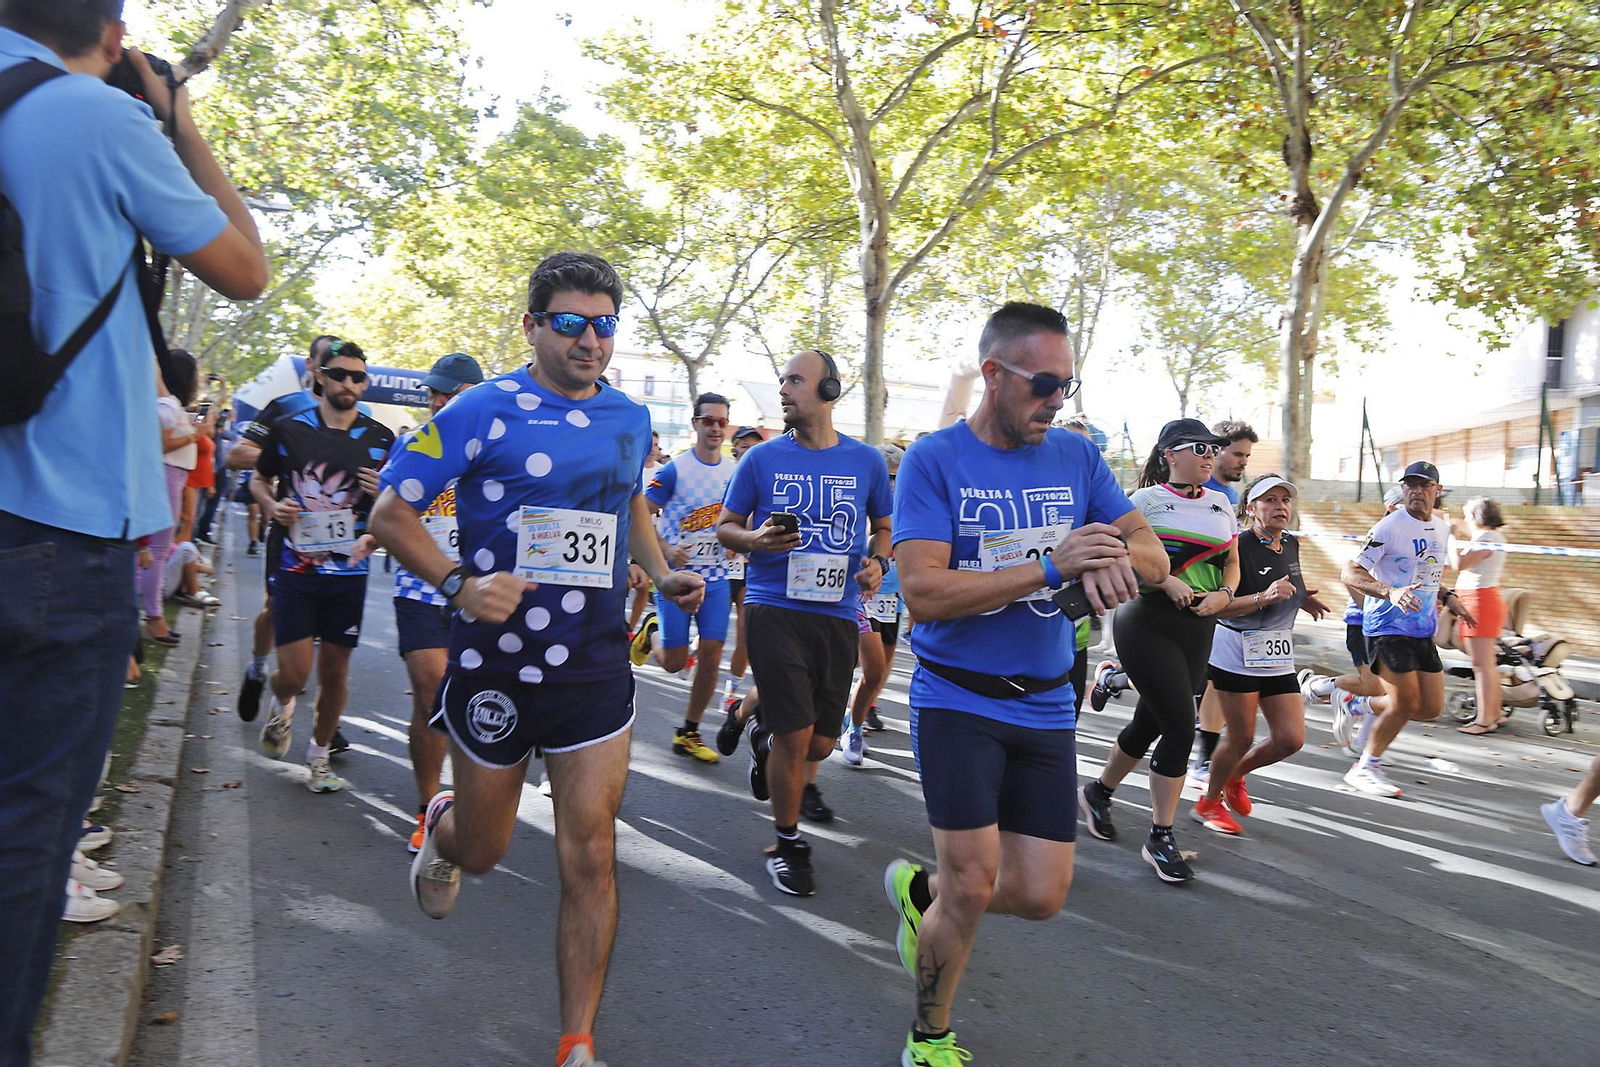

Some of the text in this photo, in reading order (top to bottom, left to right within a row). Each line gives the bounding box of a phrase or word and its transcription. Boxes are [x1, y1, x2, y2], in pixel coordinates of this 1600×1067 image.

[774, 473, 804, 482] VUELTA
[960, 487, 1013, 499] VUELTA A
[1028, 491, 1070, 502] 12/10/22
[527, 522, 560, 532] 35 VUELTA
[580, 516, 602, 526] EMILIO
[326, 521, 346, 539] 13
[537, 531, 561, 540] HUELVA
[563, 531, 609, 566] 331
[697, 542, 719, 556] 276
[990, 548, 999, 556] 35
[1000, 542, 1021, 555] VUELTA
[994, 555, 999, 563] A
[1001, 550, 1023, 562] HUELVA
[816, 567, 845, 588] 556
[1266, 640, 1290, 656] 350
